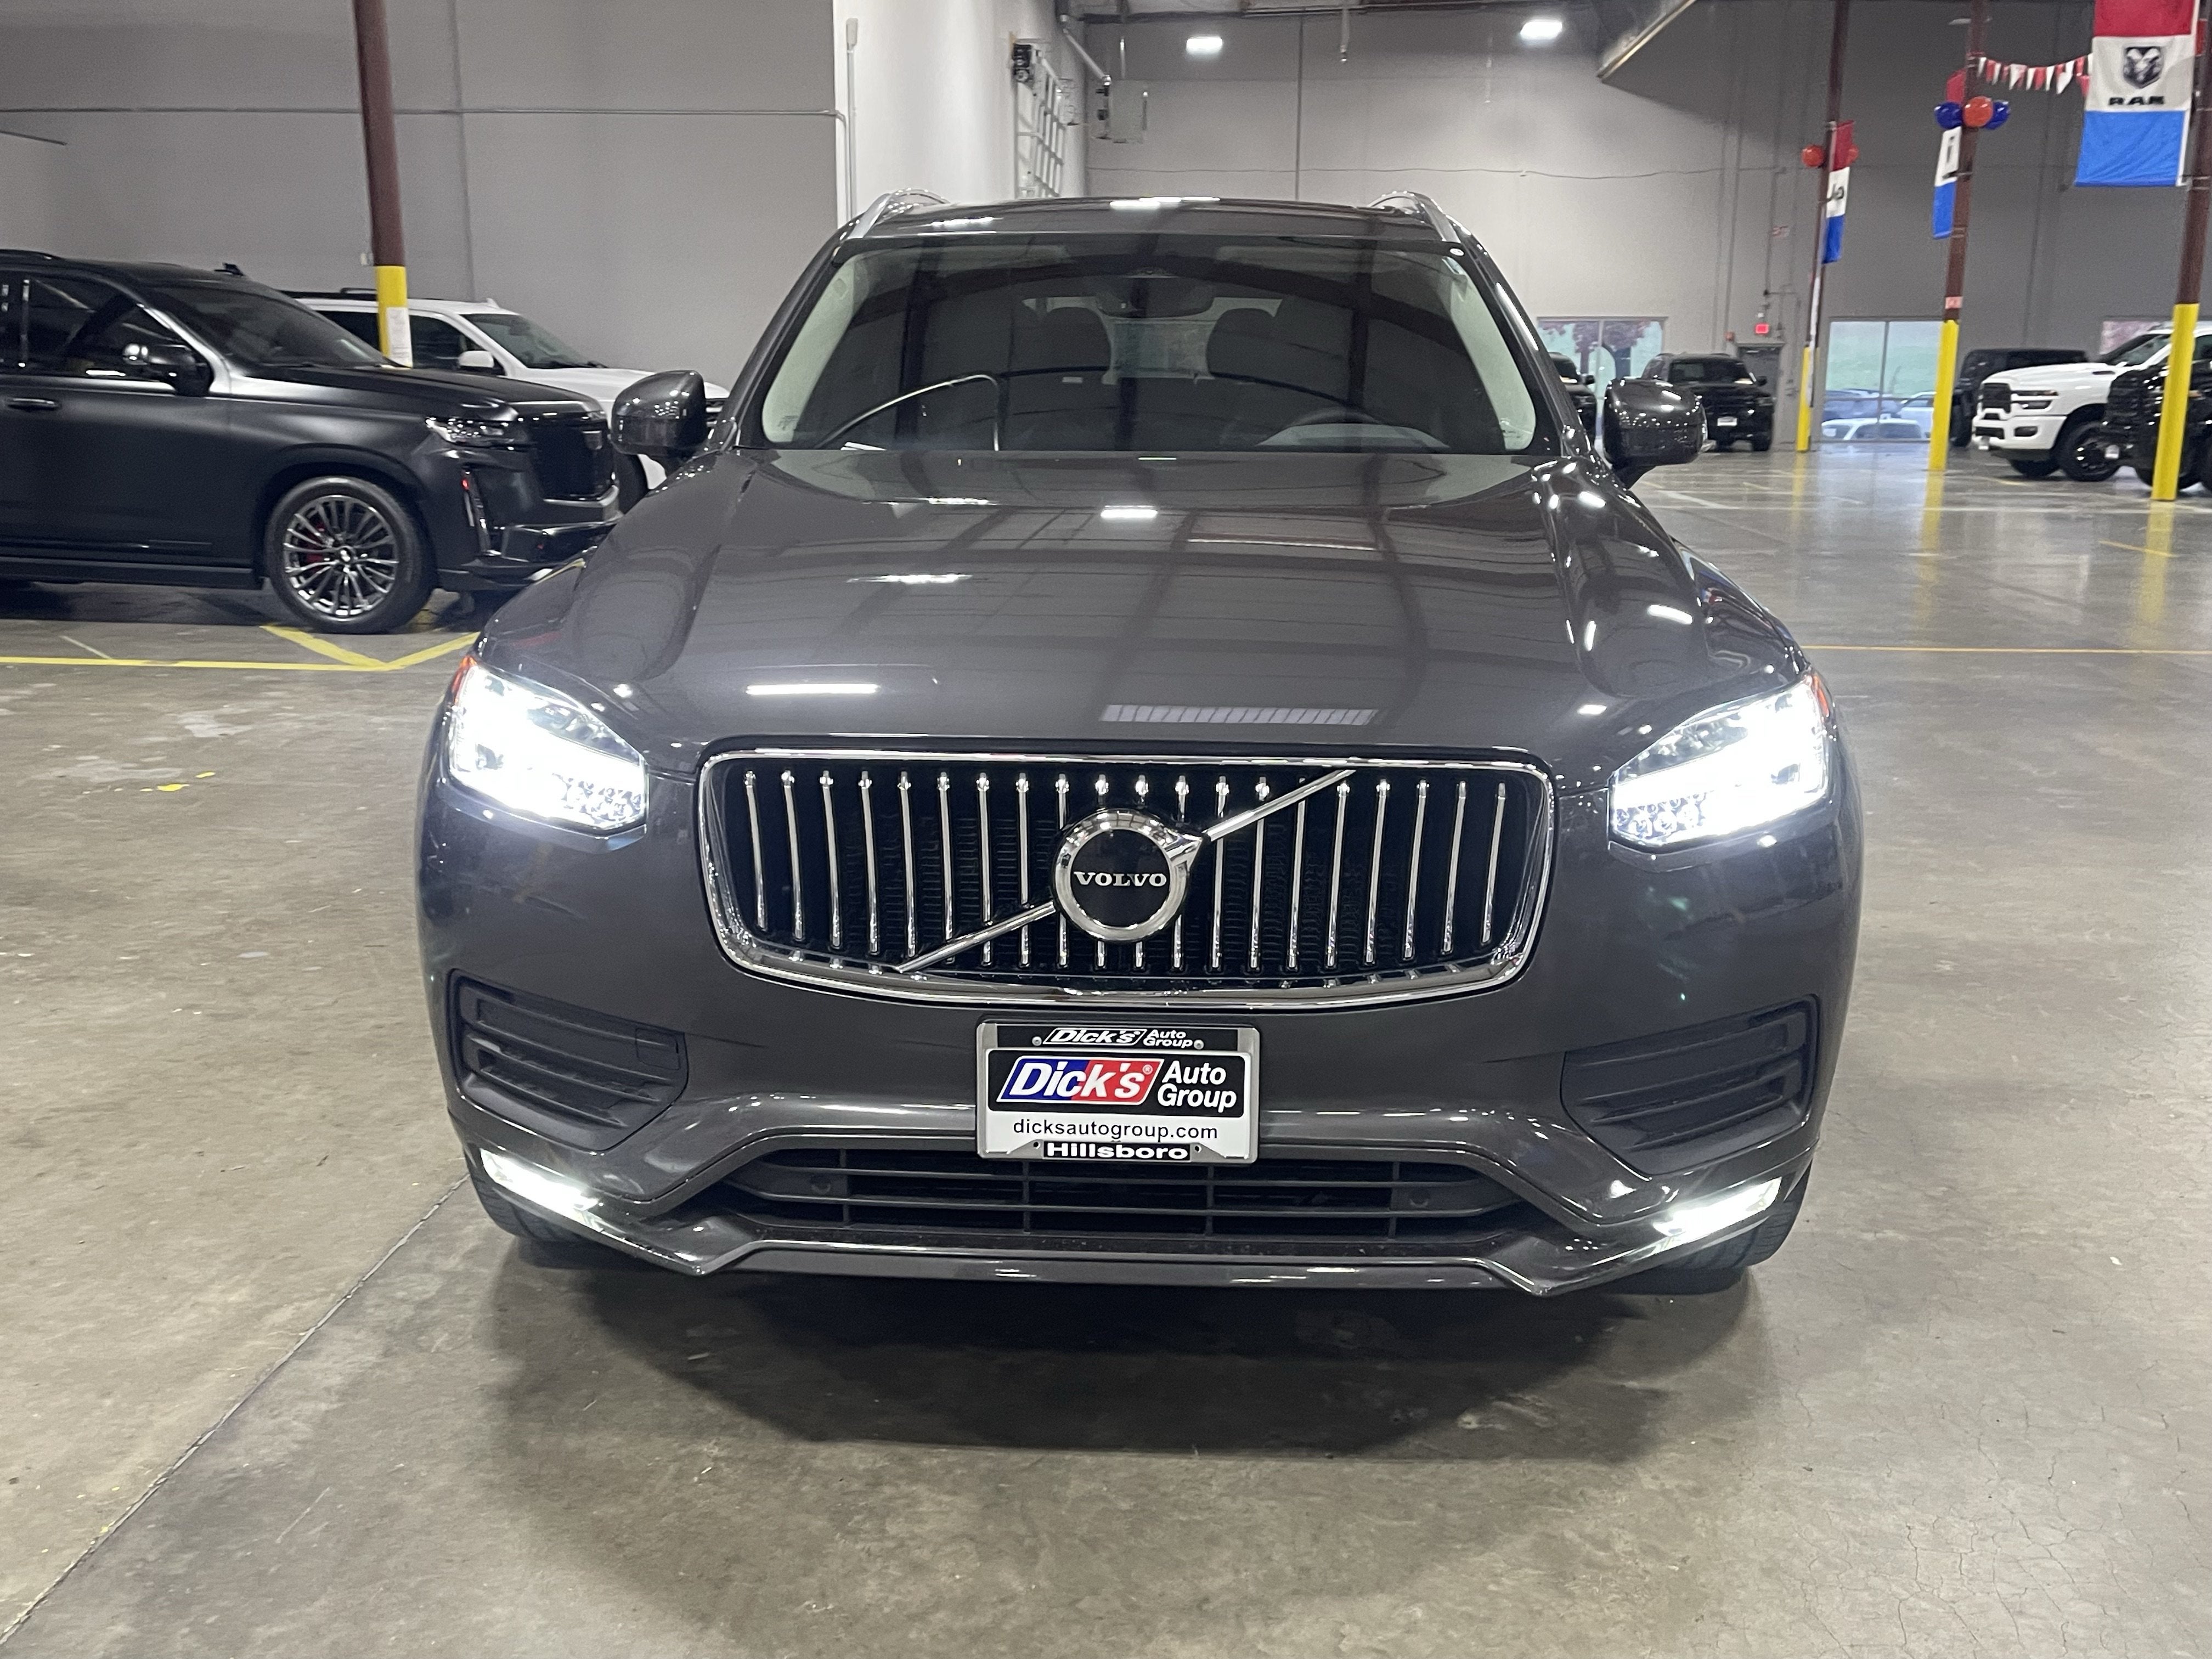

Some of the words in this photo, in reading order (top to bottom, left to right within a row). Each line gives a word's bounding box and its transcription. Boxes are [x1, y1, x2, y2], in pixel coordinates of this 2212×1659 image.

[1074, 871, 1167, 887] VOLVO
[1143, 1036, 1193, 1049] Group
[1146, 1029, 1187, 1039] Auto
[1161, 1060, 1227, 1085] Auto
[1158, 1083, 1237, 1114] Group
[1013, 1119, 1218, 1143] dicksautogroup.com
[1047, 1142, 1188, 1159] Hillsboro
